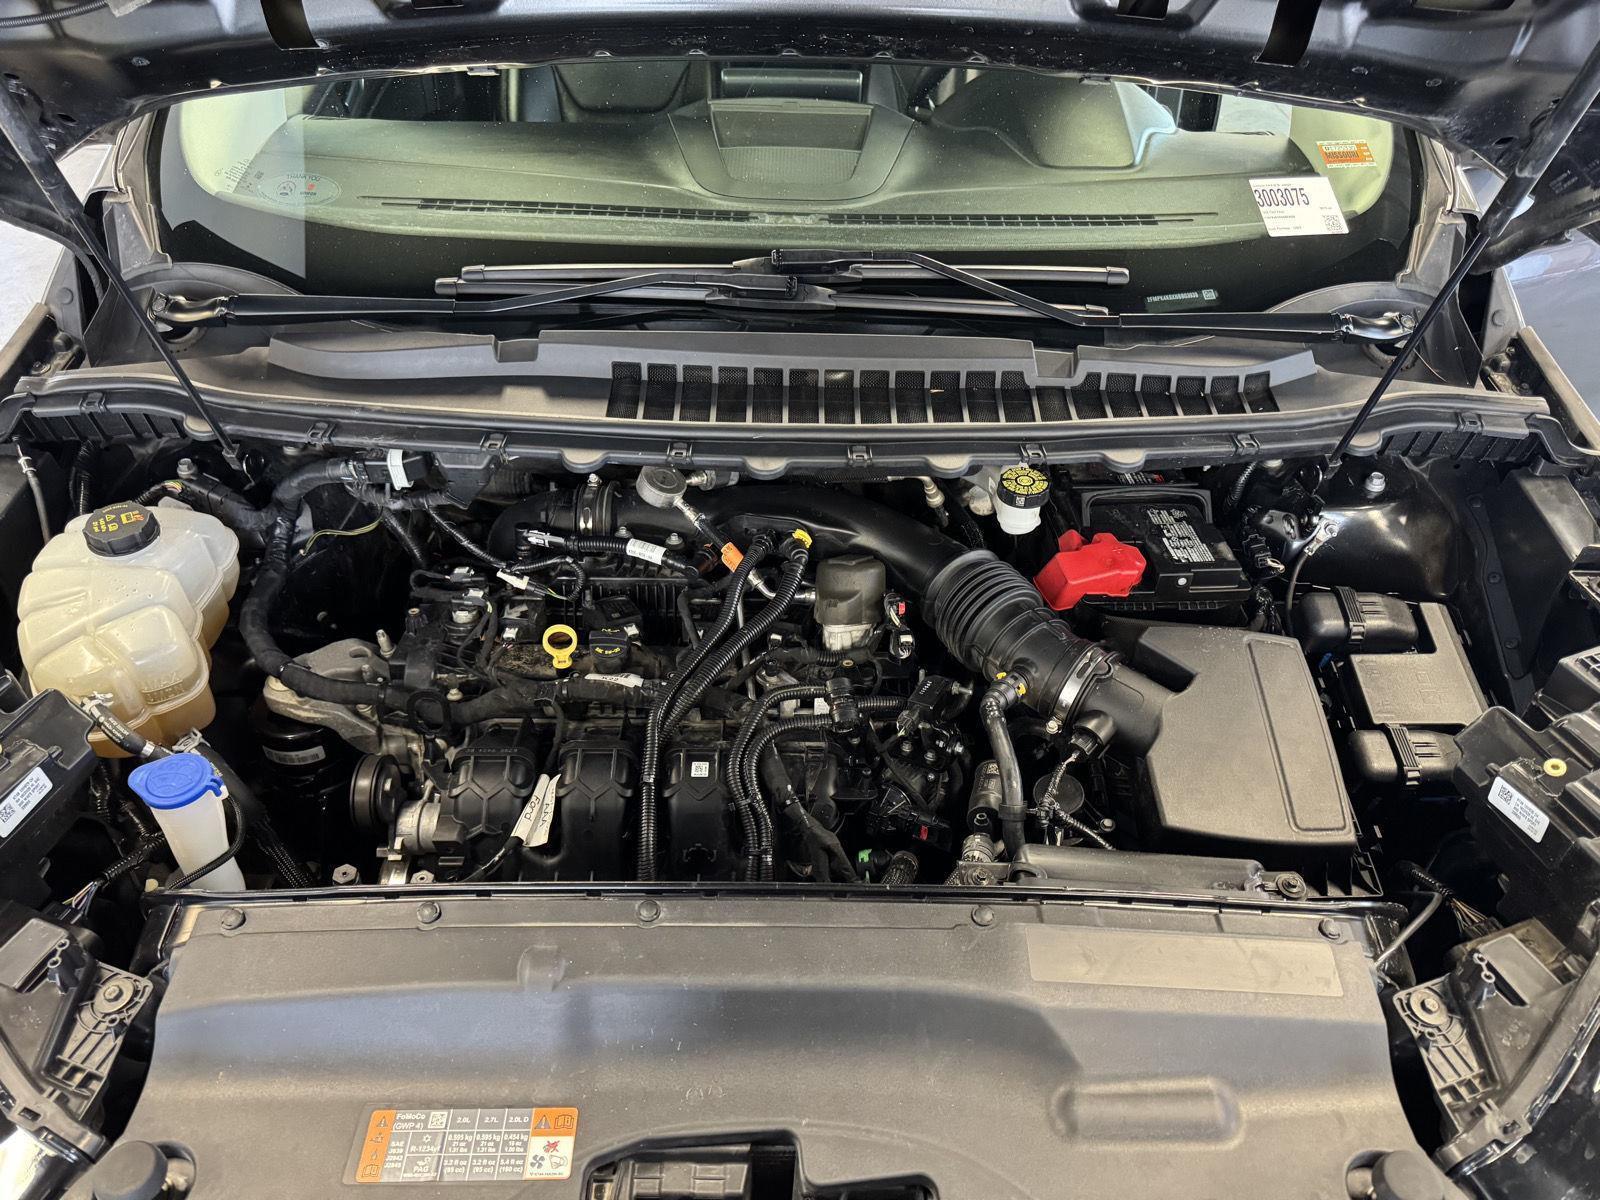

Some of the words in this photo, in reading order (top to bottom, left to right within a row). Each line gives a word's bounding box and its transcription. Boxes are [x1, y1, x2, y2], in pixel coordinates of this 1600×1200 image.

[1254, 188, 1310, 208] 3003075
[524, 795, 541, 822] Ford
[396, 1112, 426, 1121] FoMoCo
[456, 1116, 471, 1124] 2.0L
[393, 1122, 415, 1131] (GWP
[465, 1133, 473, 1142] kg
[492, 1133, 501, 1142] kg
[520, 1133, 529, 1142] kg
